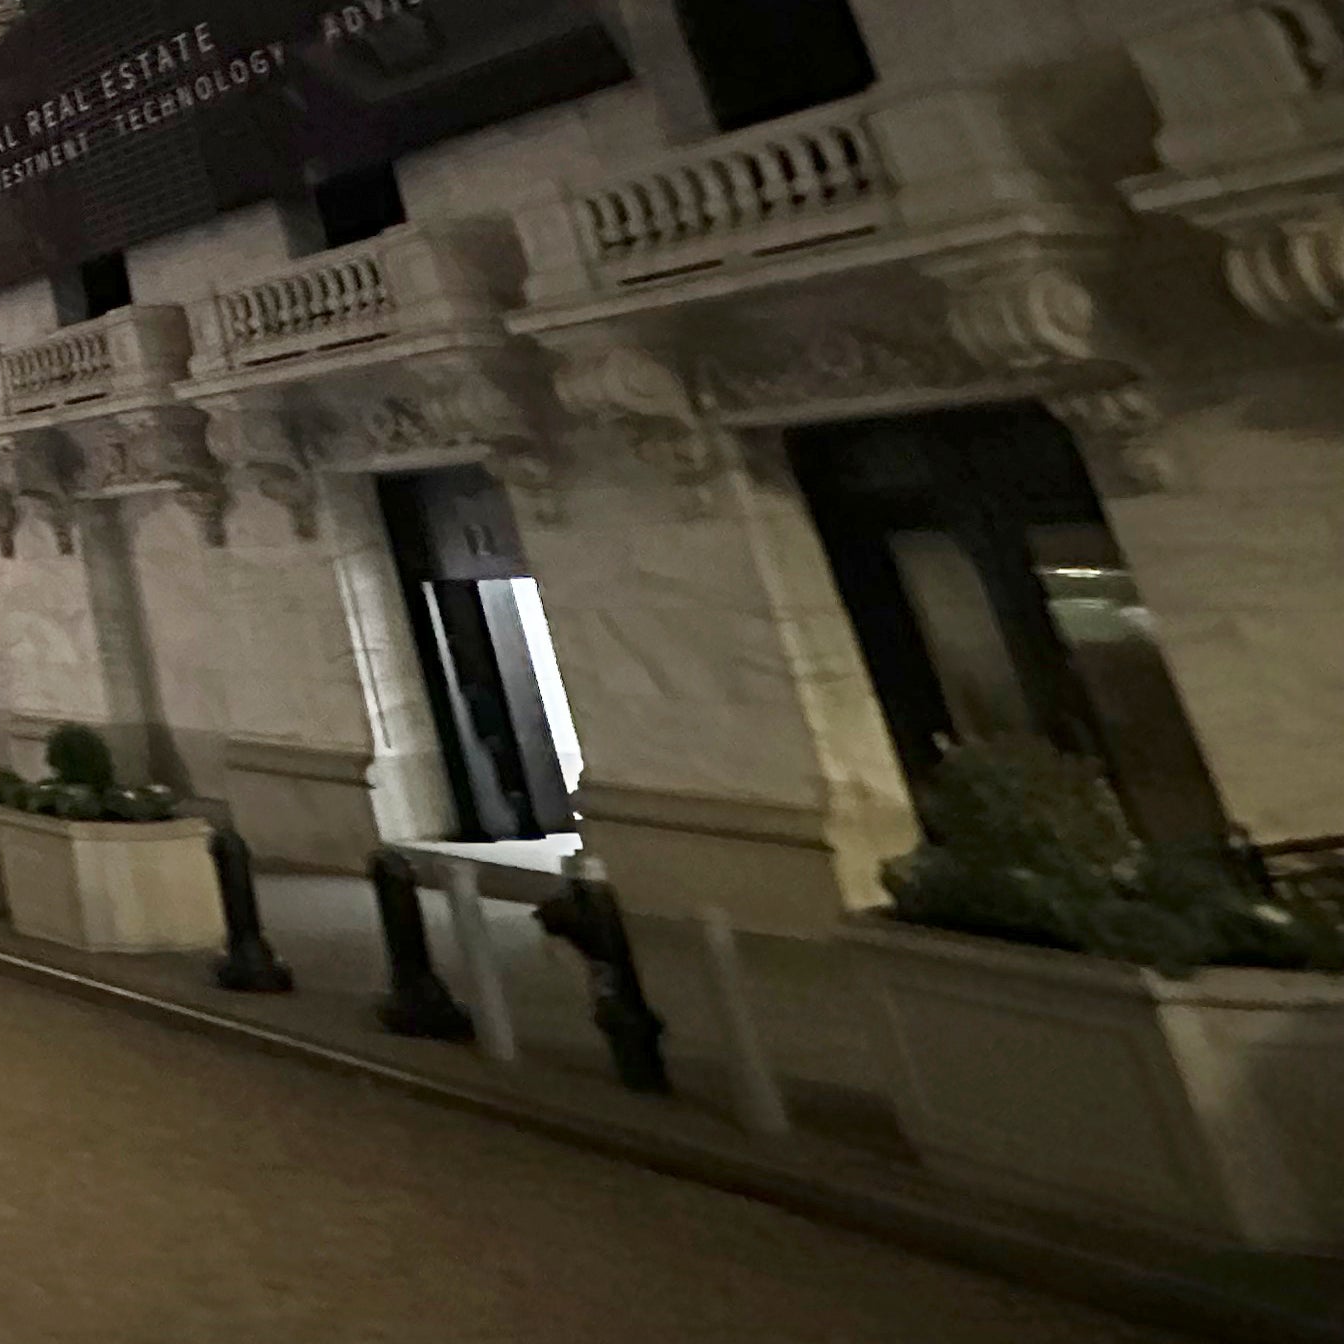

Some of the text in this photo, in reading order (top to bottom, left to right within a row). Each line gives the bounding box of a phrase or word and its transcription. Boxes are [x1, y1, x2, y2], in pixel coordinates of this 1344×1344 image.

[26, 87, 92, 136] REAL
[100, 21, 216, 99] ESTATE
[112, 41, 288, 137] TECHNOLOGY
